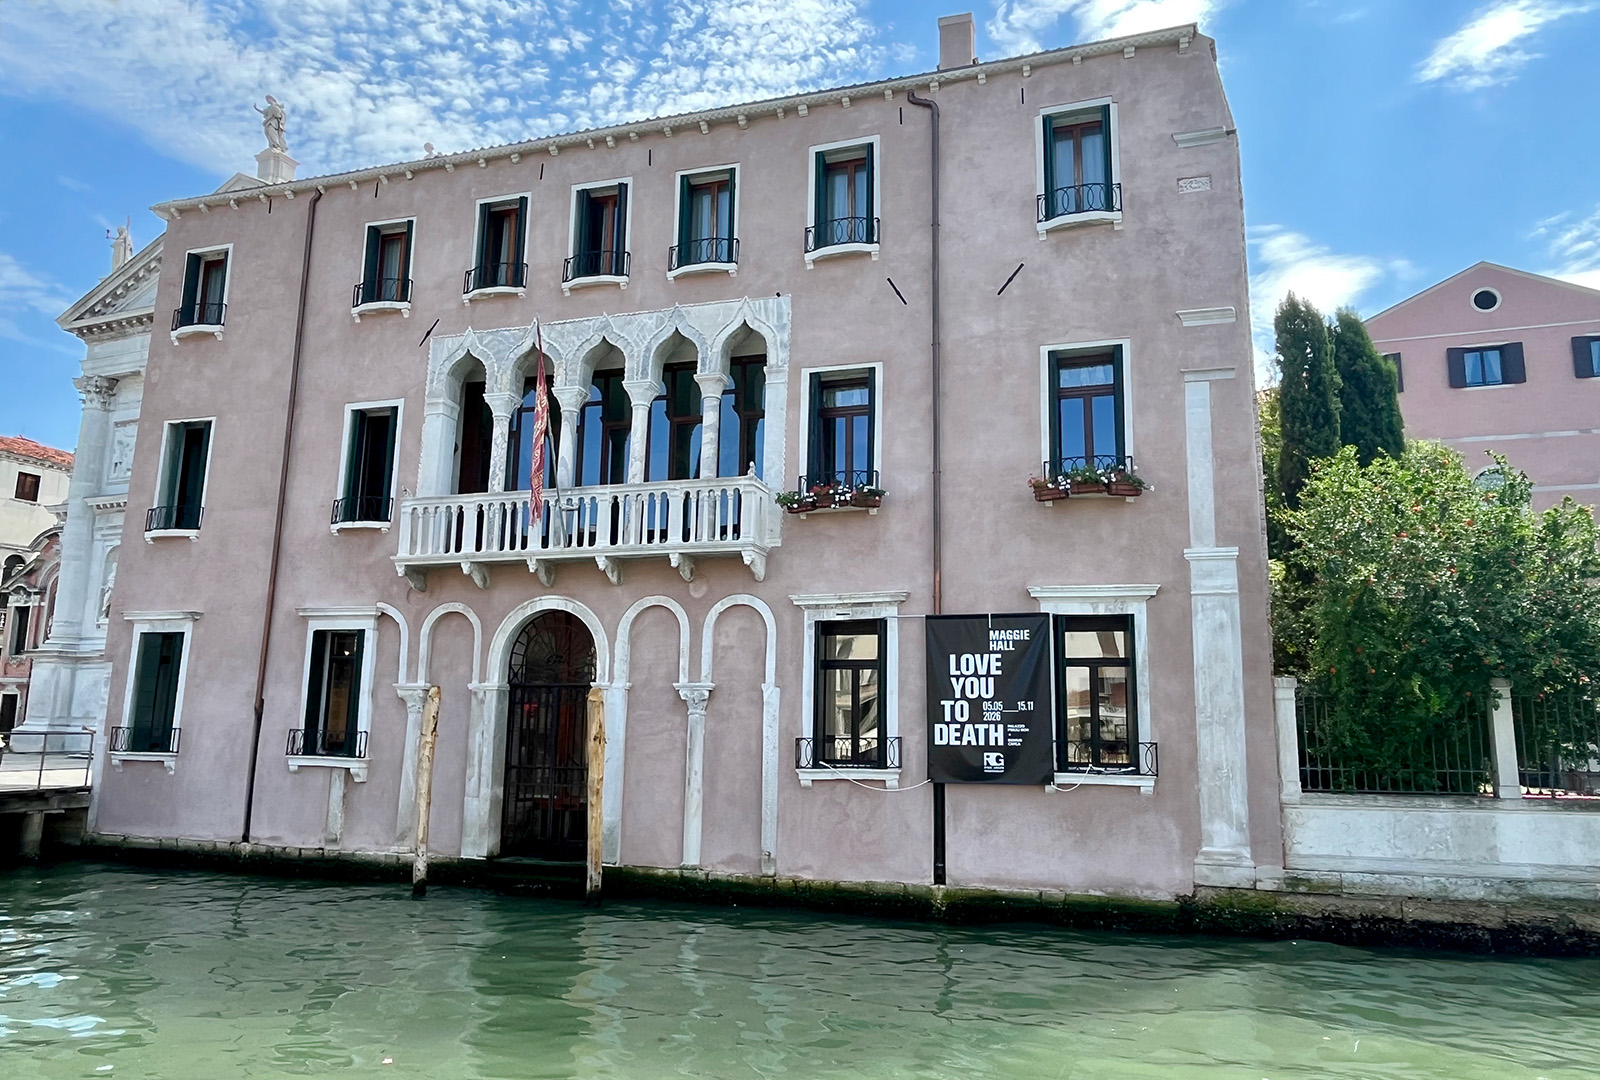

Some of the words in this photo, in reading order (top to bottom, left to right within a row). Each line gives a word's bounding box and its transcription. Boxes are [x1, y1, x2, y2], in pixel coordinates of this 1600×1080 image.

[989, 630, 1030, 640] MAGGIE
[989, 641, 1015, 651] HALL
[949, 653, 1002, 676] LOVE
[950, 676, 995, 699] YOU
[940, 700, 969, 722] TO
[982, 711, 1001, 721] 2026
[934, 723, 1004, 746] DEATH
